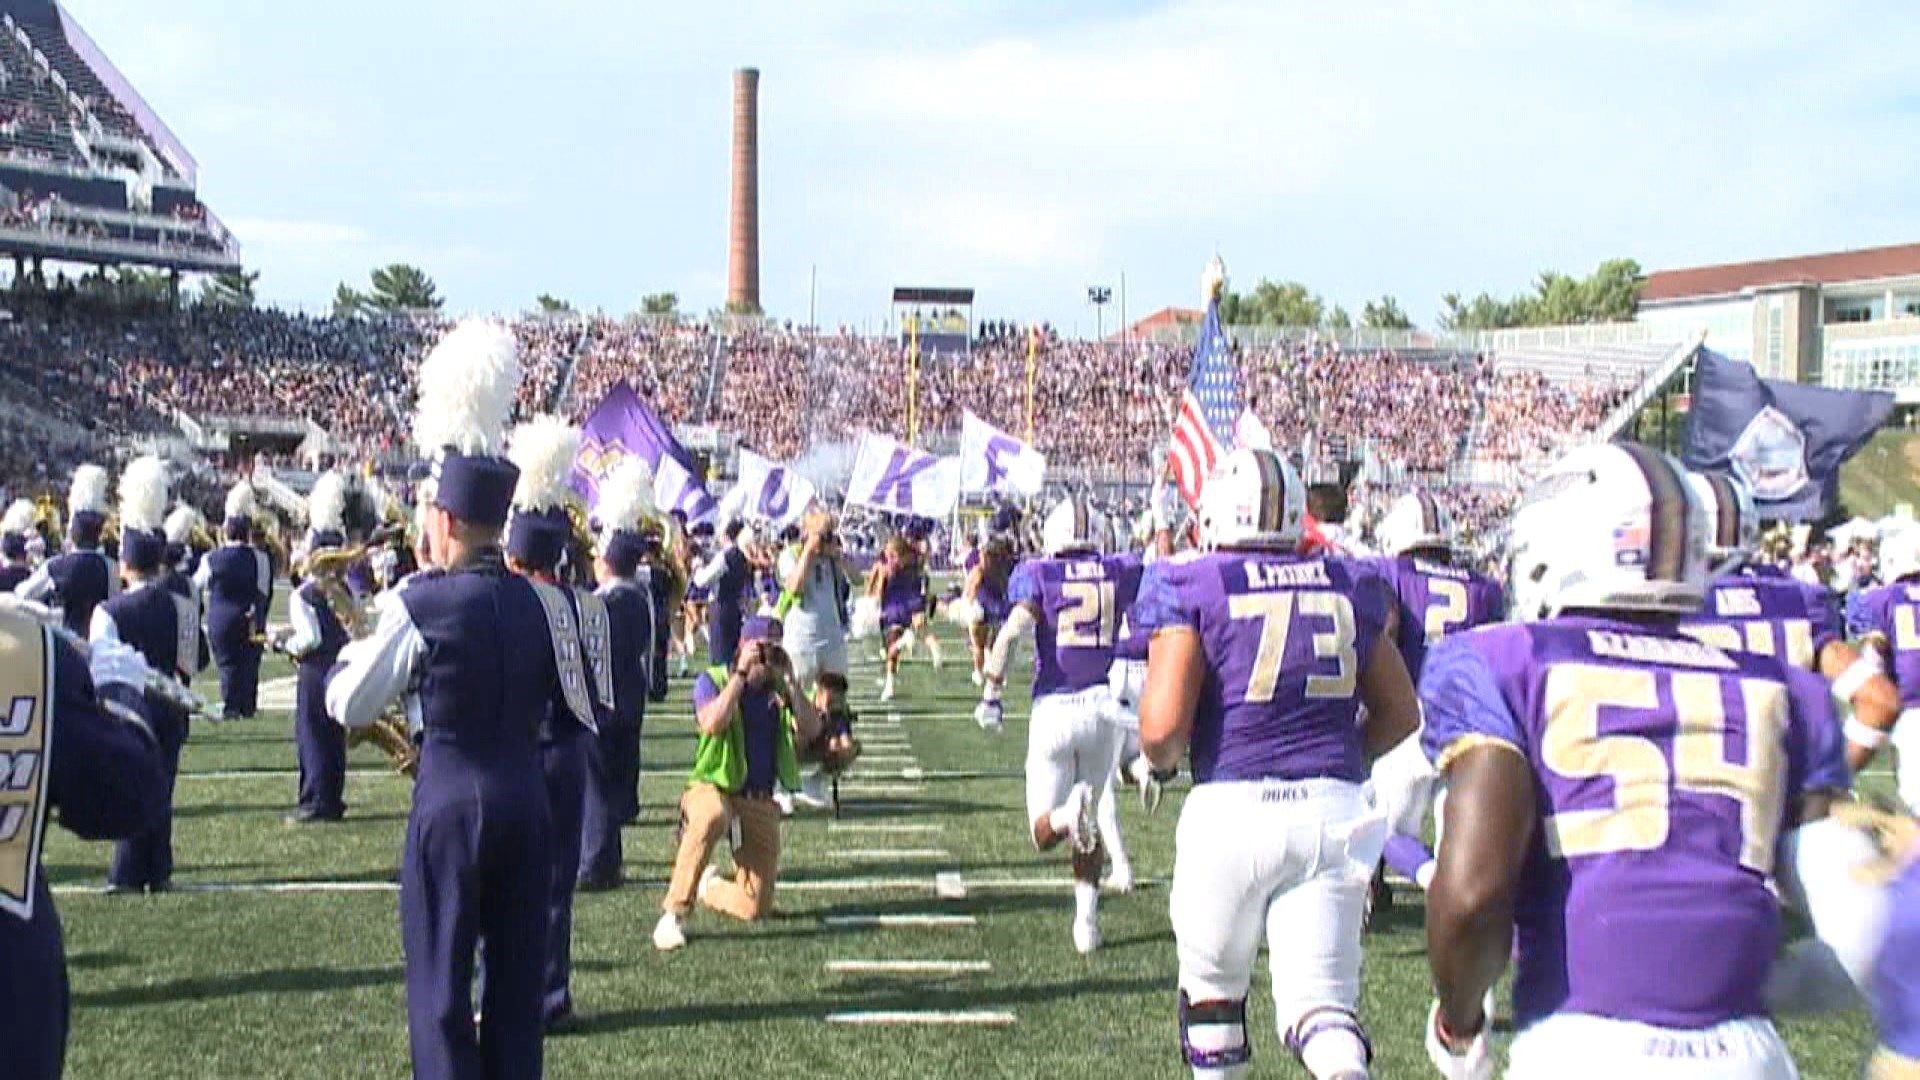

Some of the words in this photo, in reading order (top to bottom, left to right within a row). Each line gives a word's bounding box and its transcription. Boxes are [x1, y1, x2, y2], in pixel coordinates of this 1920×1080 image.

[868, 447, 937, 511] K
[1056, 581, 1116, 647] 21
[1424, 577, 1468, 645] 2
[1228, 590, 1358, 703] 73
[1541, 661, 1790, 876] 54
